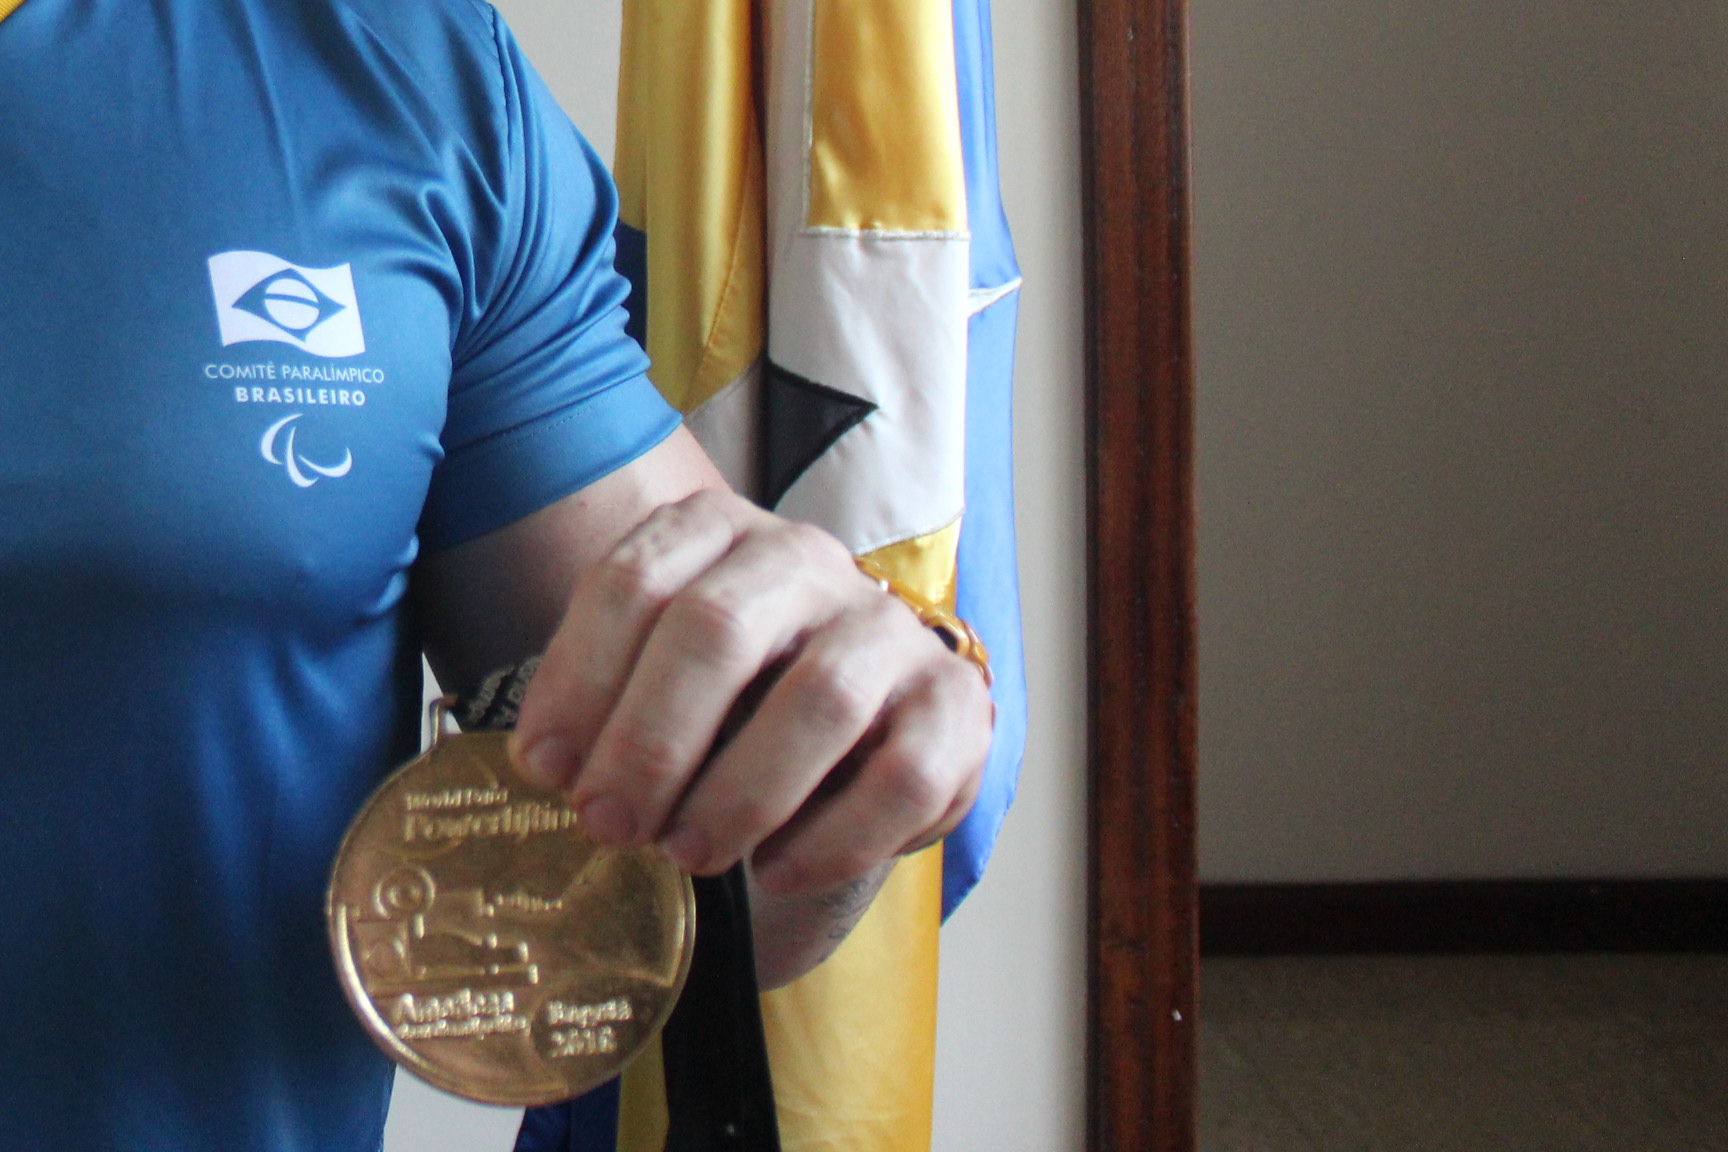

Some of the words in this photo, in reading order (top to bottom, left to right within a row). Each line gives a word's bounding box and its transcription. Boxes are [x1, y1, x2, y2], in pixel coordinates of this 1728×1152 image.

[204, 361, 277, 379] COMITÊ
[282, 363, 385, 384] PARALÍMPICO
[235, 386, 367, 406] BRASILEIRO
